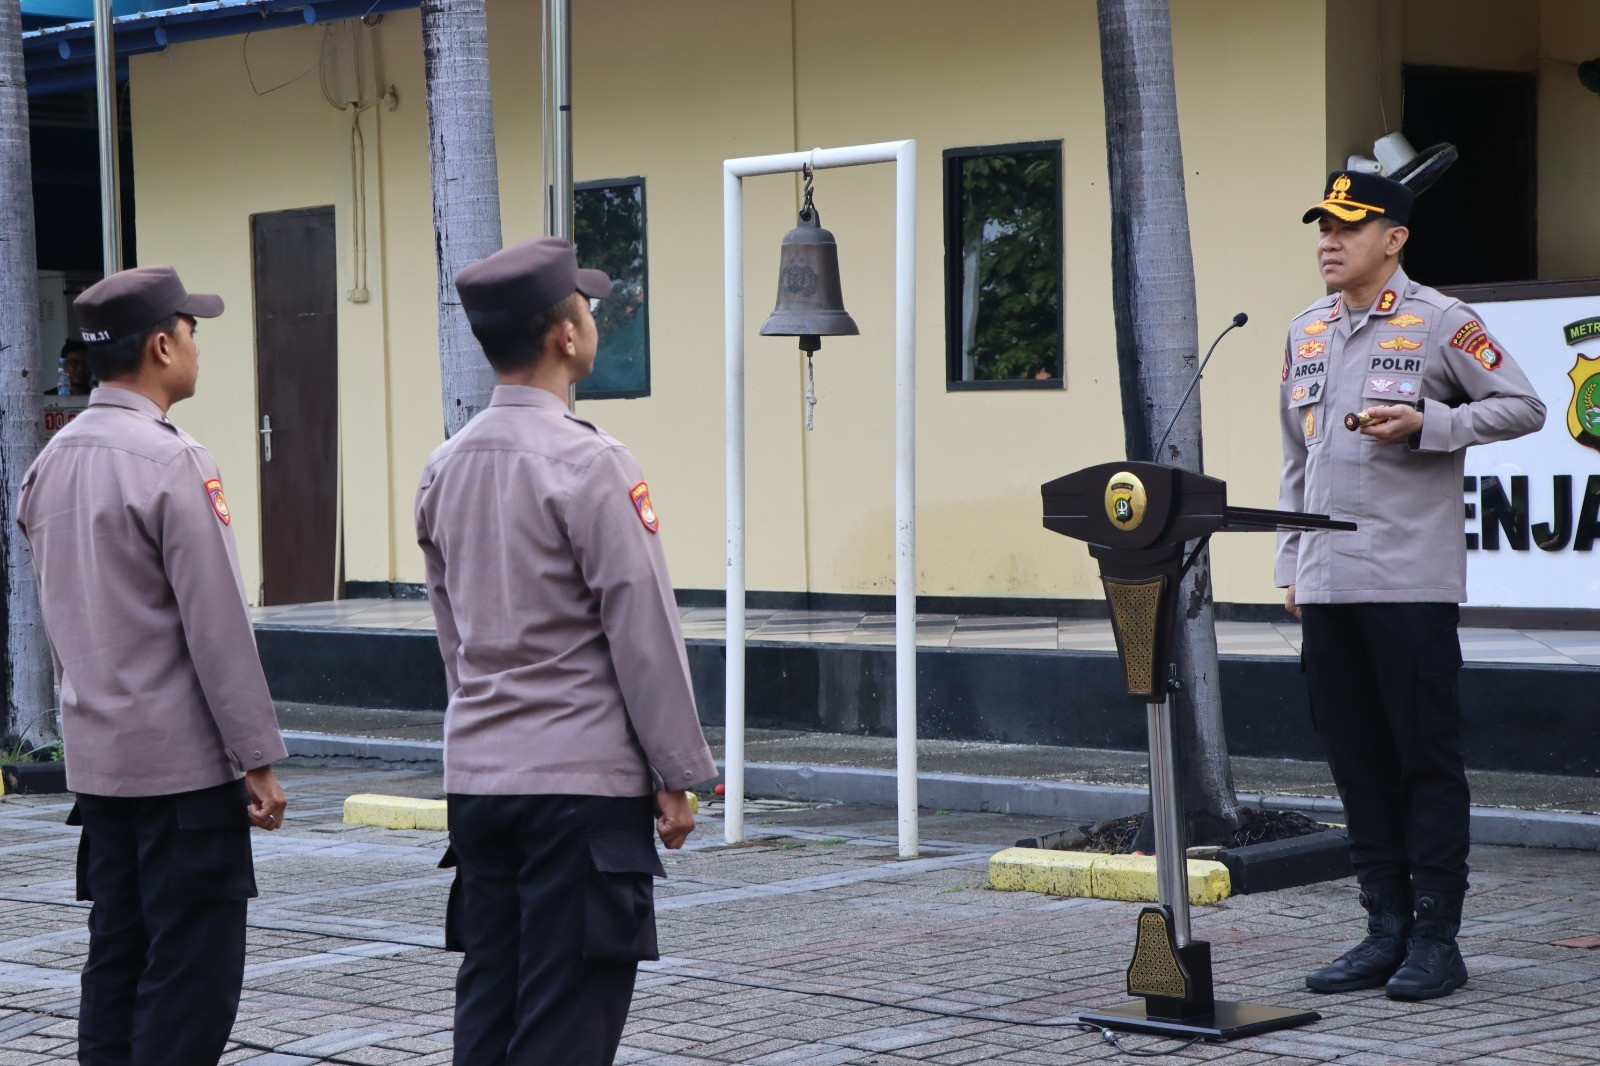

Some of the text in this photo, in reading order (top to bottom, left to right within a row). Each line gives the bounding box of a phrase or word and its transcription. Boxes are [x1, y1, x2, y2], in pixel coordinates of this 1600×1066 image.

[1452, 321, 1478, 345] POLRES
[1294, 361, 1325, 378] ARGA
[1371, 358, 1420, 372] POLRI
